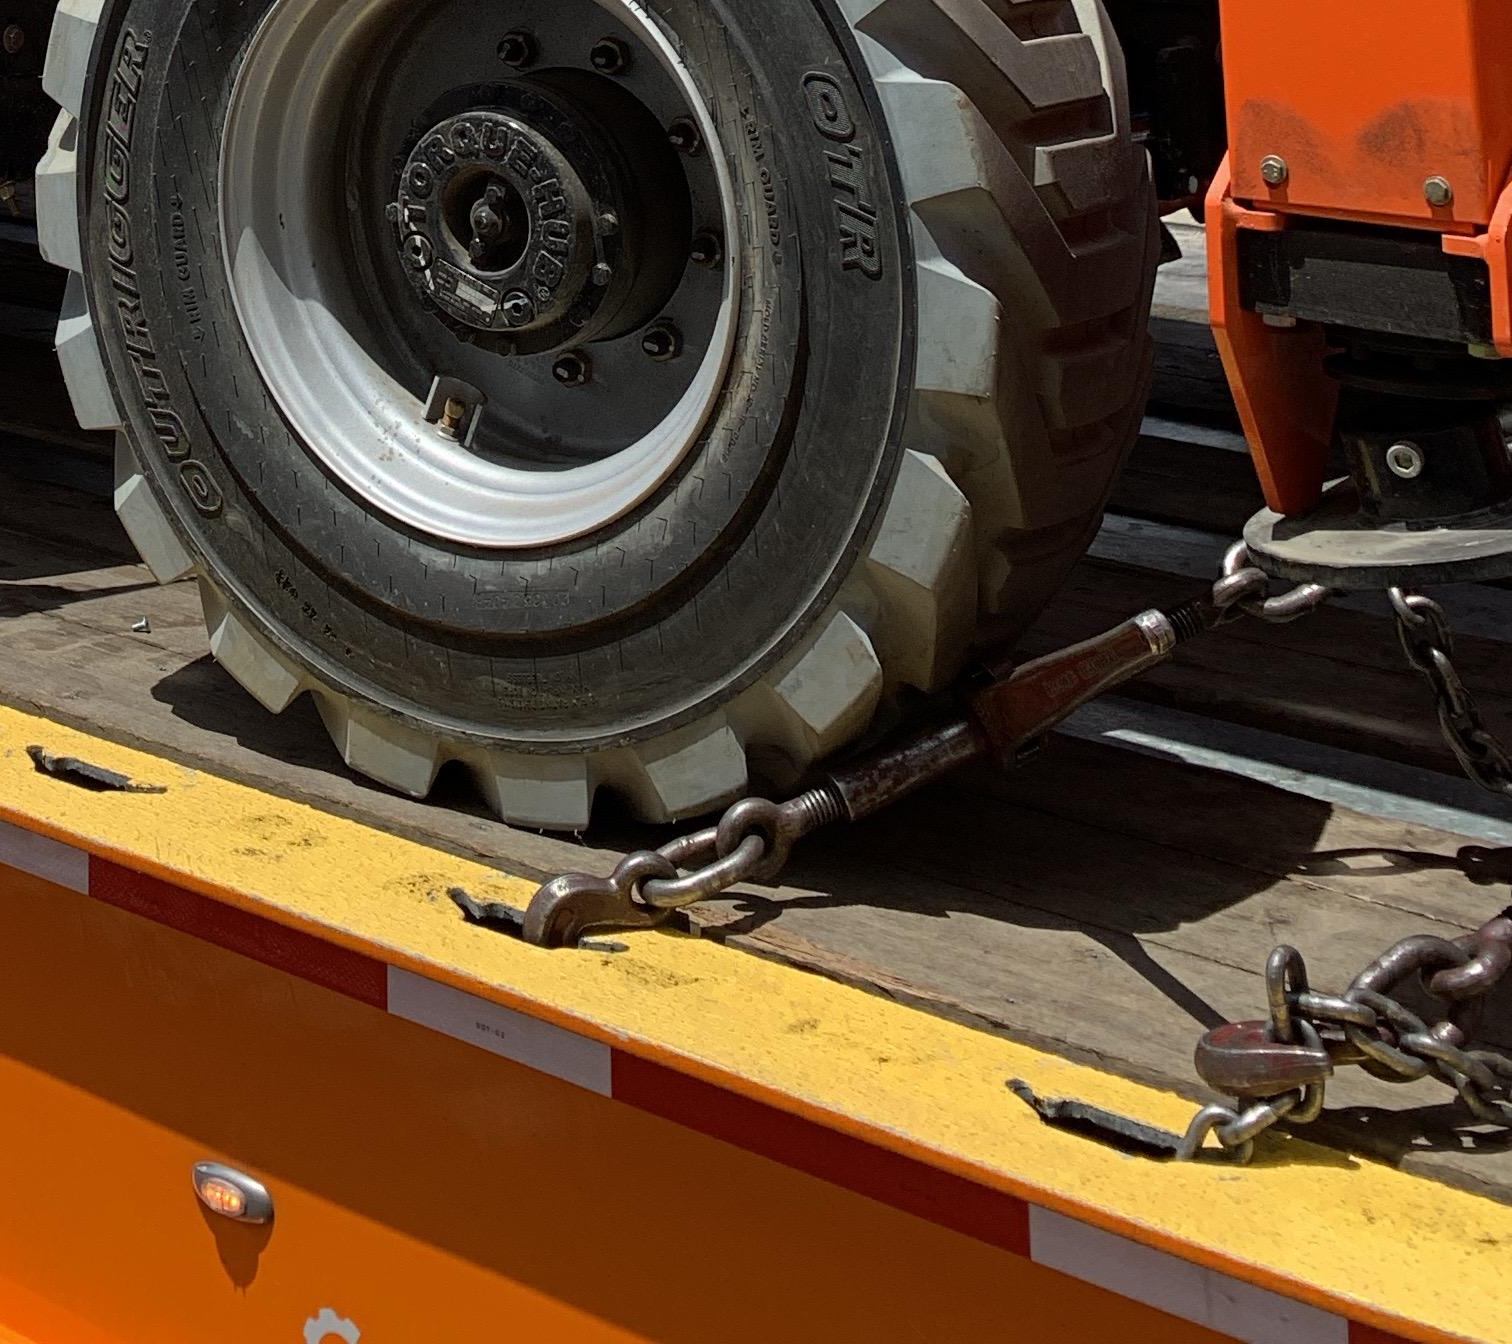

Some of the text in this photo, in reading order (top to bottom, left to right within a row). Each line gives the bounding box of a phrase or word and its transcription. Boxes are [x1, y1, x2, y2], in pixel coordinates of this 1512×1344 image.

[104, 26, 223, 516] OUTRIGGER
[745, 120, 782, 247] RIM GUARD
[802, 70, 883, 282] OTR
